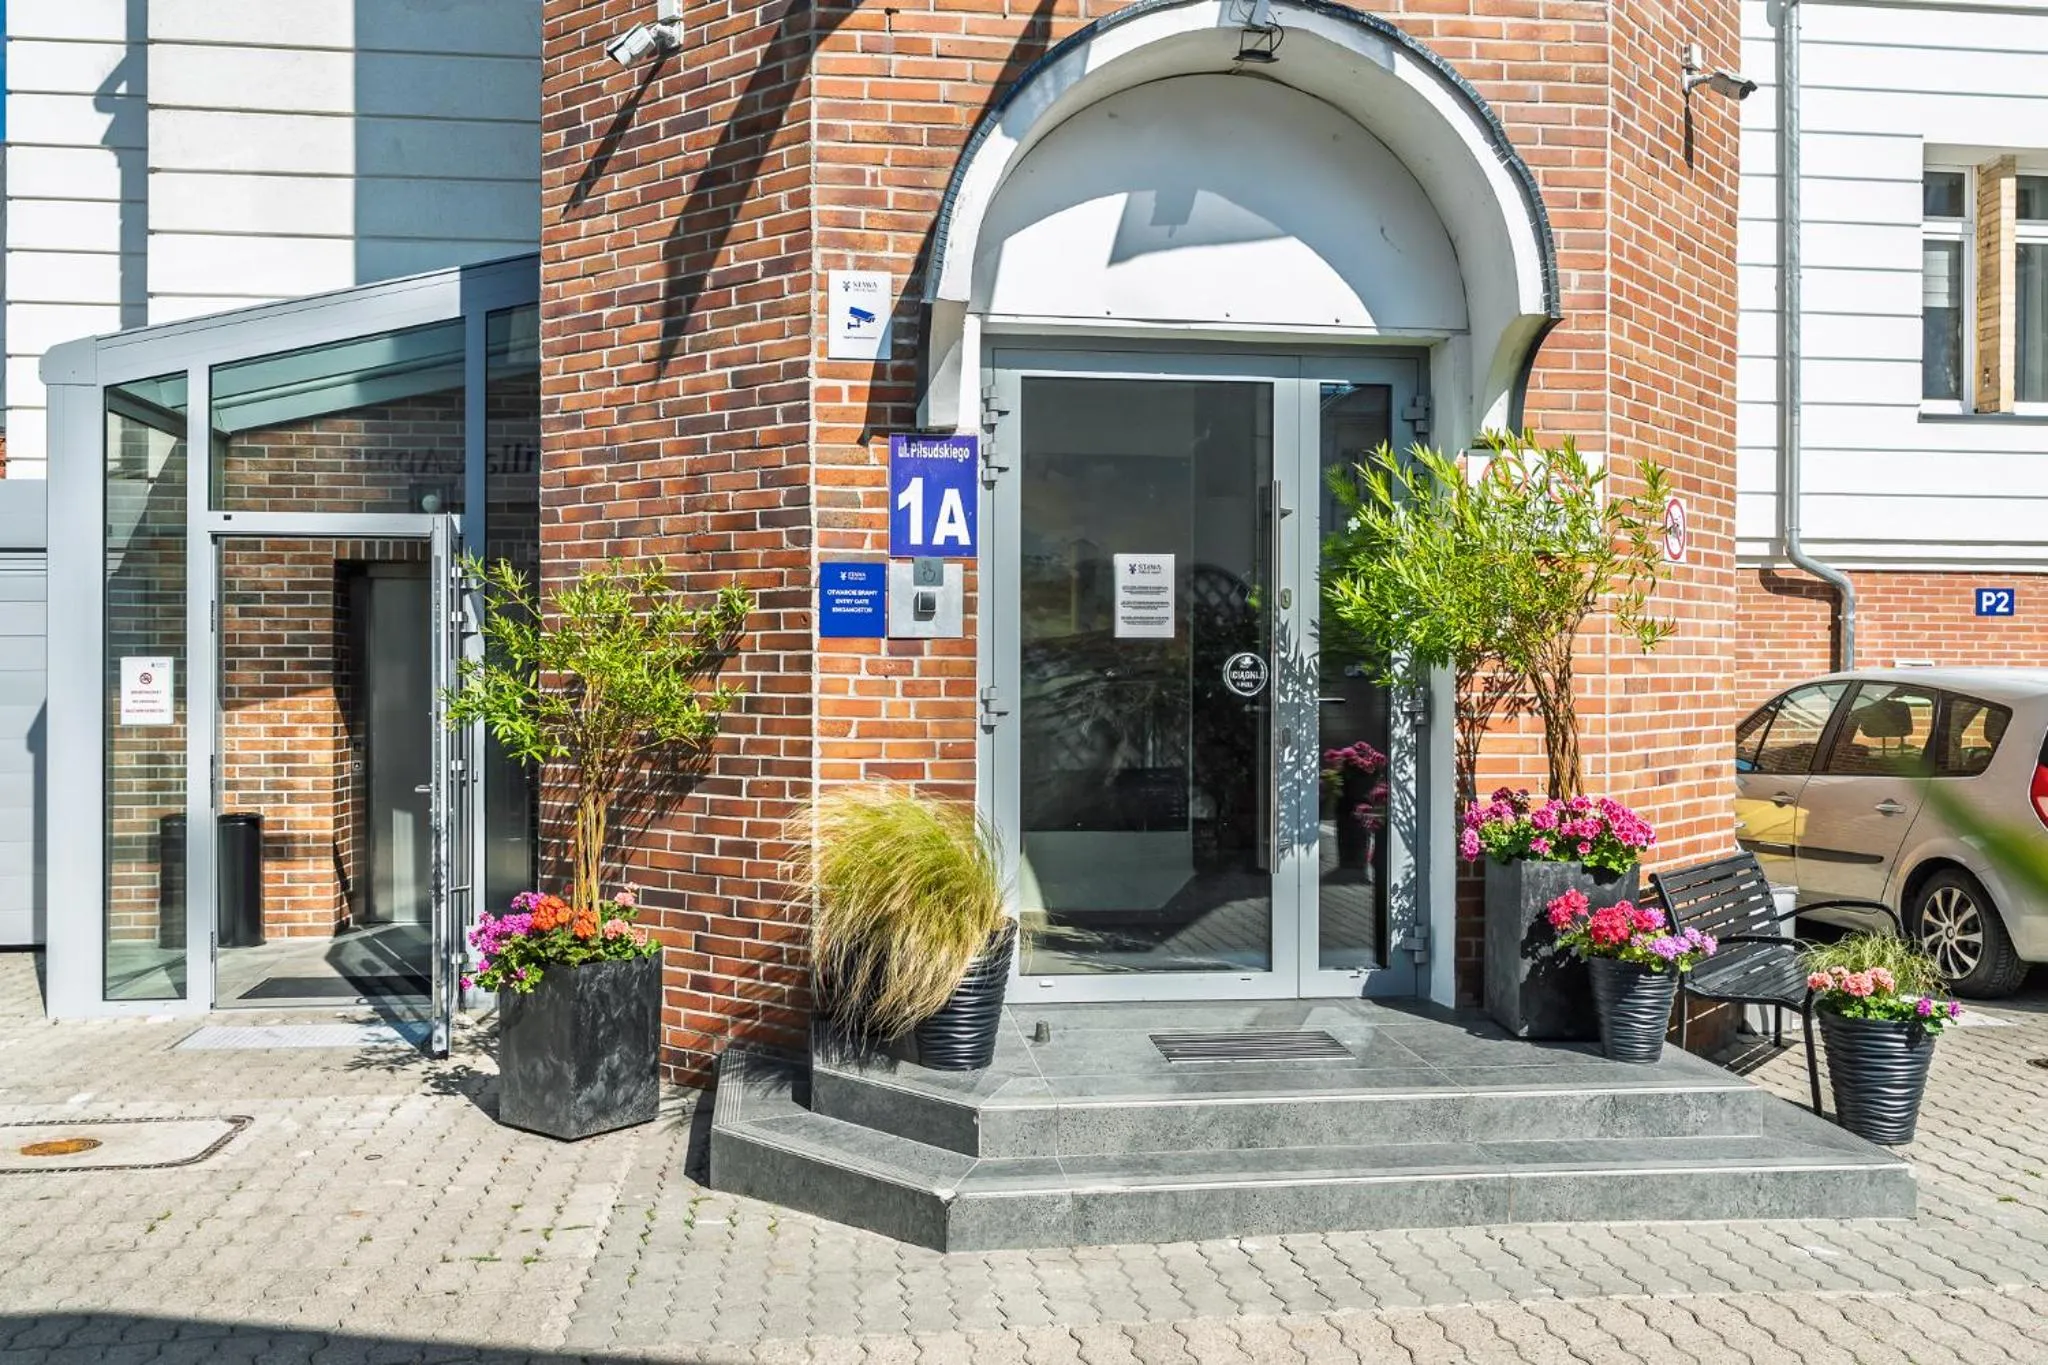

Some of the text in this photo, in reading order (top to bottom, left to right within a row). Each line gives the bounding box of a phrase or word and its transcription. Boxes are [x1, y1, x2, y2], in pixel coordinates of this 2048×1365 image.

[898, 442, 970, 463] ul. Piłsudskiego
[1982, 591, 2009, 612] P2
